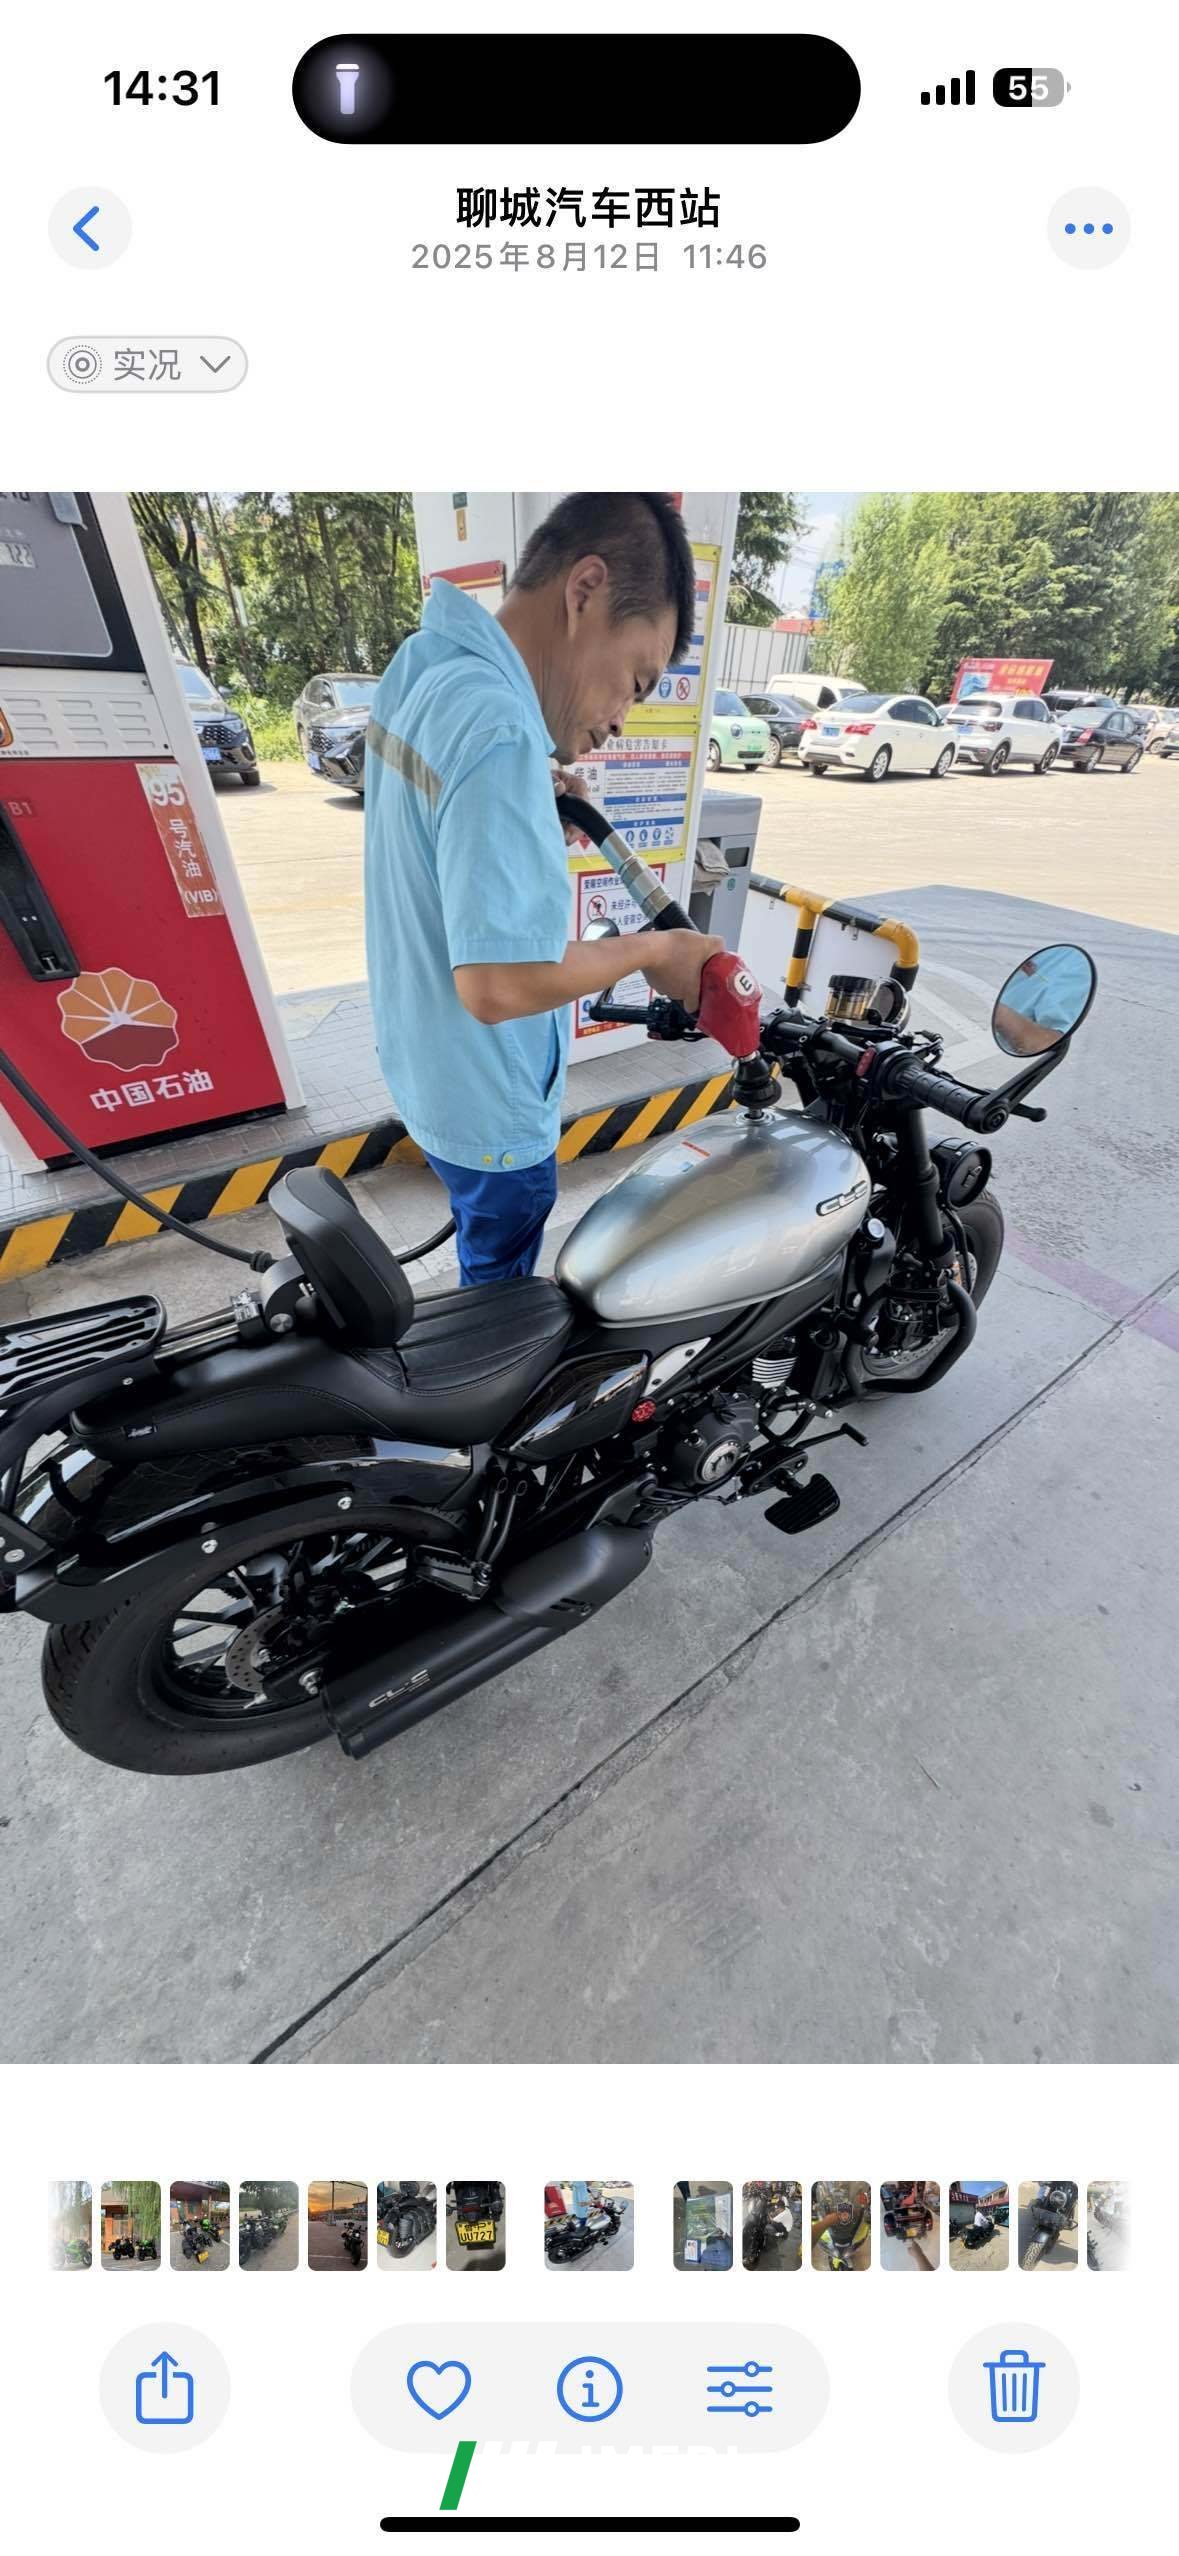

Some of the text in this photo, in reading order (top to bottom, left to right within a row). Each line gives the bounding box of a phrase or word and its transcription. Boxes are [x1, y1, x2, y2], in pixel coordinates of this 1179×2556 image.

[104, 69, 221, 107] 14:31
[1008, 75, 1049, 101] 55
[455, 186, 722, 230] 聊城汽车西站
[410, 240, 768, 274] 2025年8月12日 11:46
[113, 346, 183, 383] 实况
[602, 738, 668, 752] 业病危害告知卡
[8, 801, 32, 816] B1
[150, 779, 185, 807] 95
[168, 817, 203, 879] 号汽油
[584, 876, 624, 889] 受限空间作业
[739, 974, 753, 992] E
[88, 1068, 215, 1112] 中国石油
